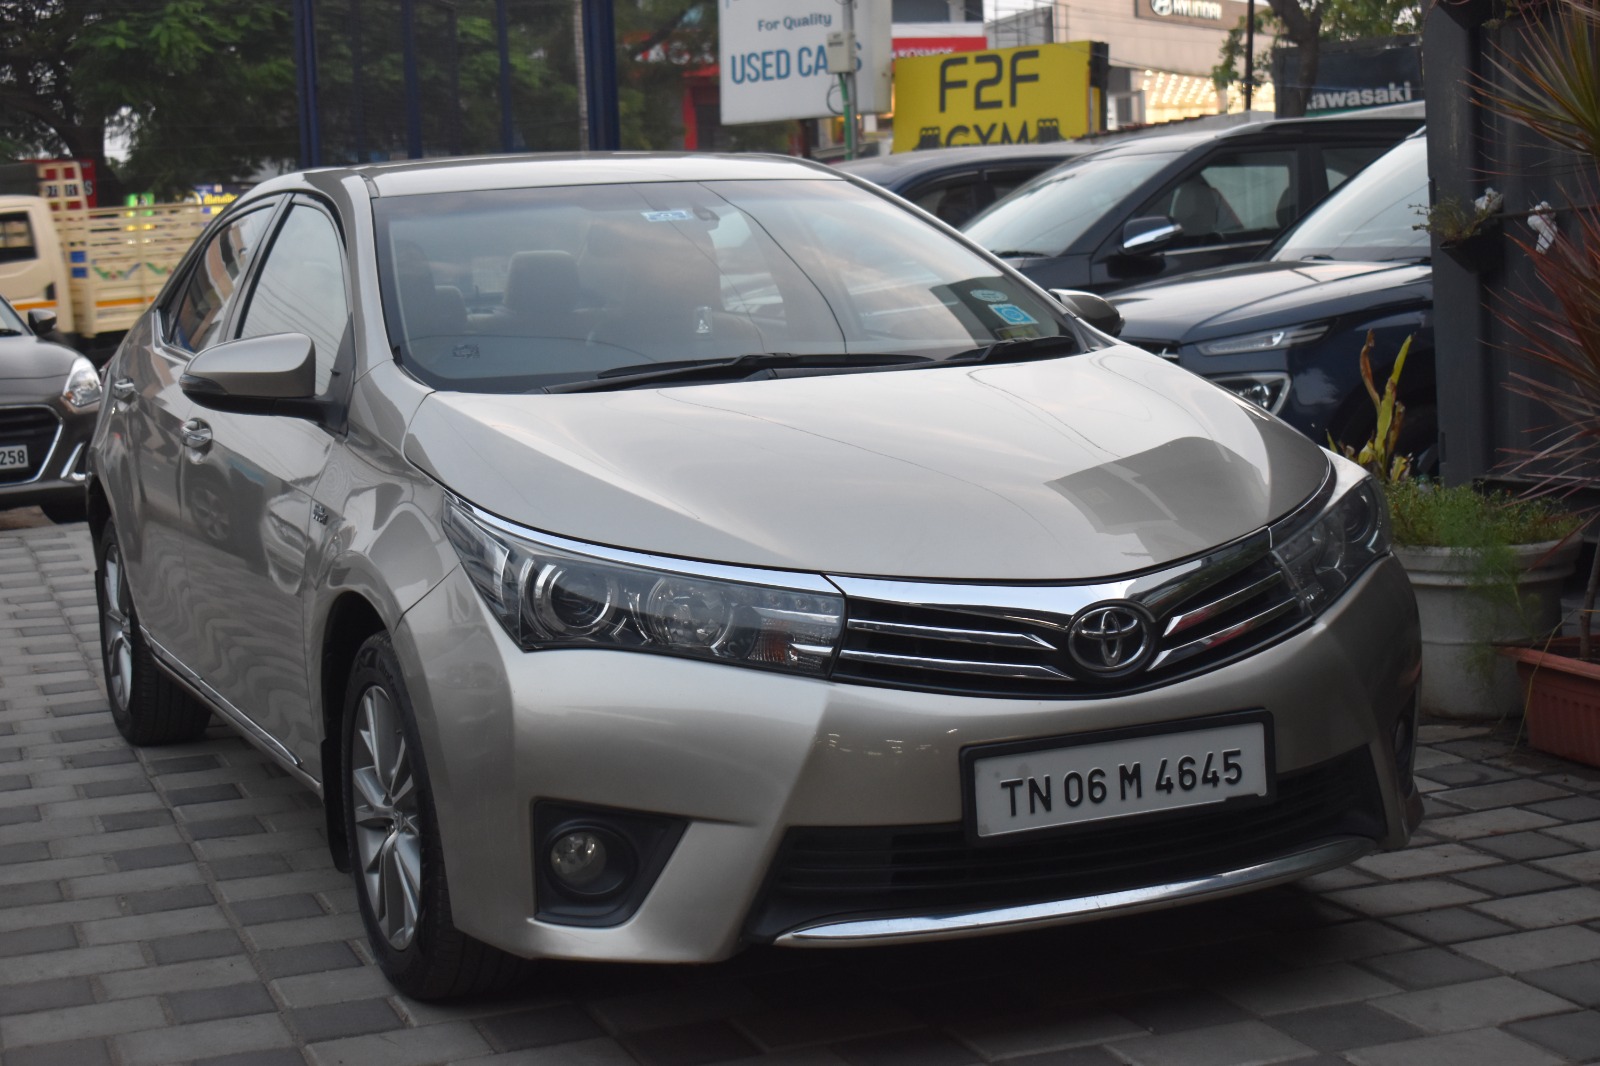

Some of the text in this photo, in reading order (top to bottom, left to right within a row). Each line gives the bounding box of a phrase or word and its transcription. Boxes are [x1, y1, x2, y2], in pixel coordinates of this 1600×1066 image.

[758, 13, 832, 32] For Quality
[1174, 0, 1222, 20] HYUNDAI
[731, 49, 791, 84] USED
[798, 42, 862, 77] CAS
[939, 50, 1039, 113] F2F
[945, 121, 1029, 147] GYM
[0, 450, 26, 465] 258
[1001, 748, 1243, 817] TN 06 M 4645
